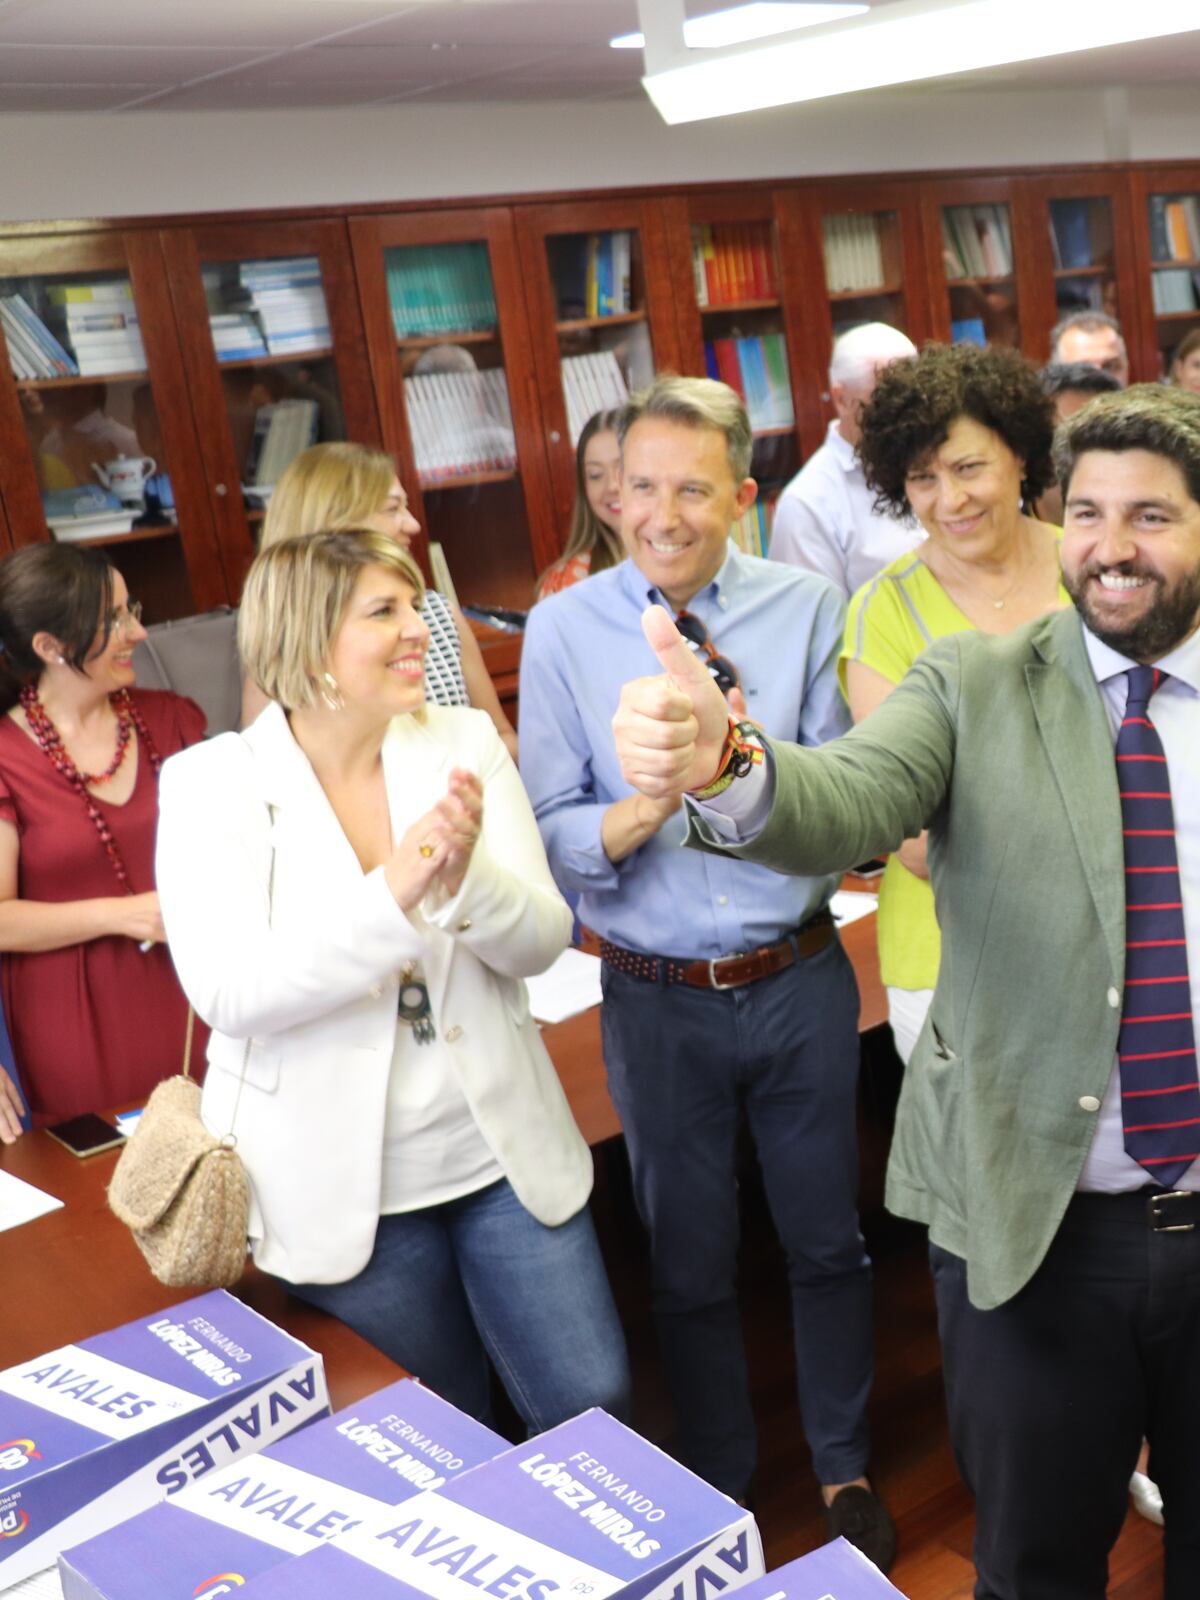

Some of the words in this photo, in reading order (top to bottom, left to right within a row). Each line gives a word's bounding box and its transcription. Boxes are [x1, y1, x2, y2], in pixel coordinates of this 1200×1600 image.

[147, 1319, 202, 1356] LÓPEZ
[188, 1317, 252, 1363] FERNANDO
[21, 1363, 157, 1419] AVALES
[156, 1366, 316, 1496] AVALES
[336, 1417, 404, 1463] LÓPEZ
[388, 1454, 446, 1490] MIRA
[380, 1414, 464, 1470] FERNANDO
[518, 1453, 597, 1510] LÓPEZ
[579, 1500, 661, 1559] MIRAS
[568, 1451, 666, 1522] FERNANDO
